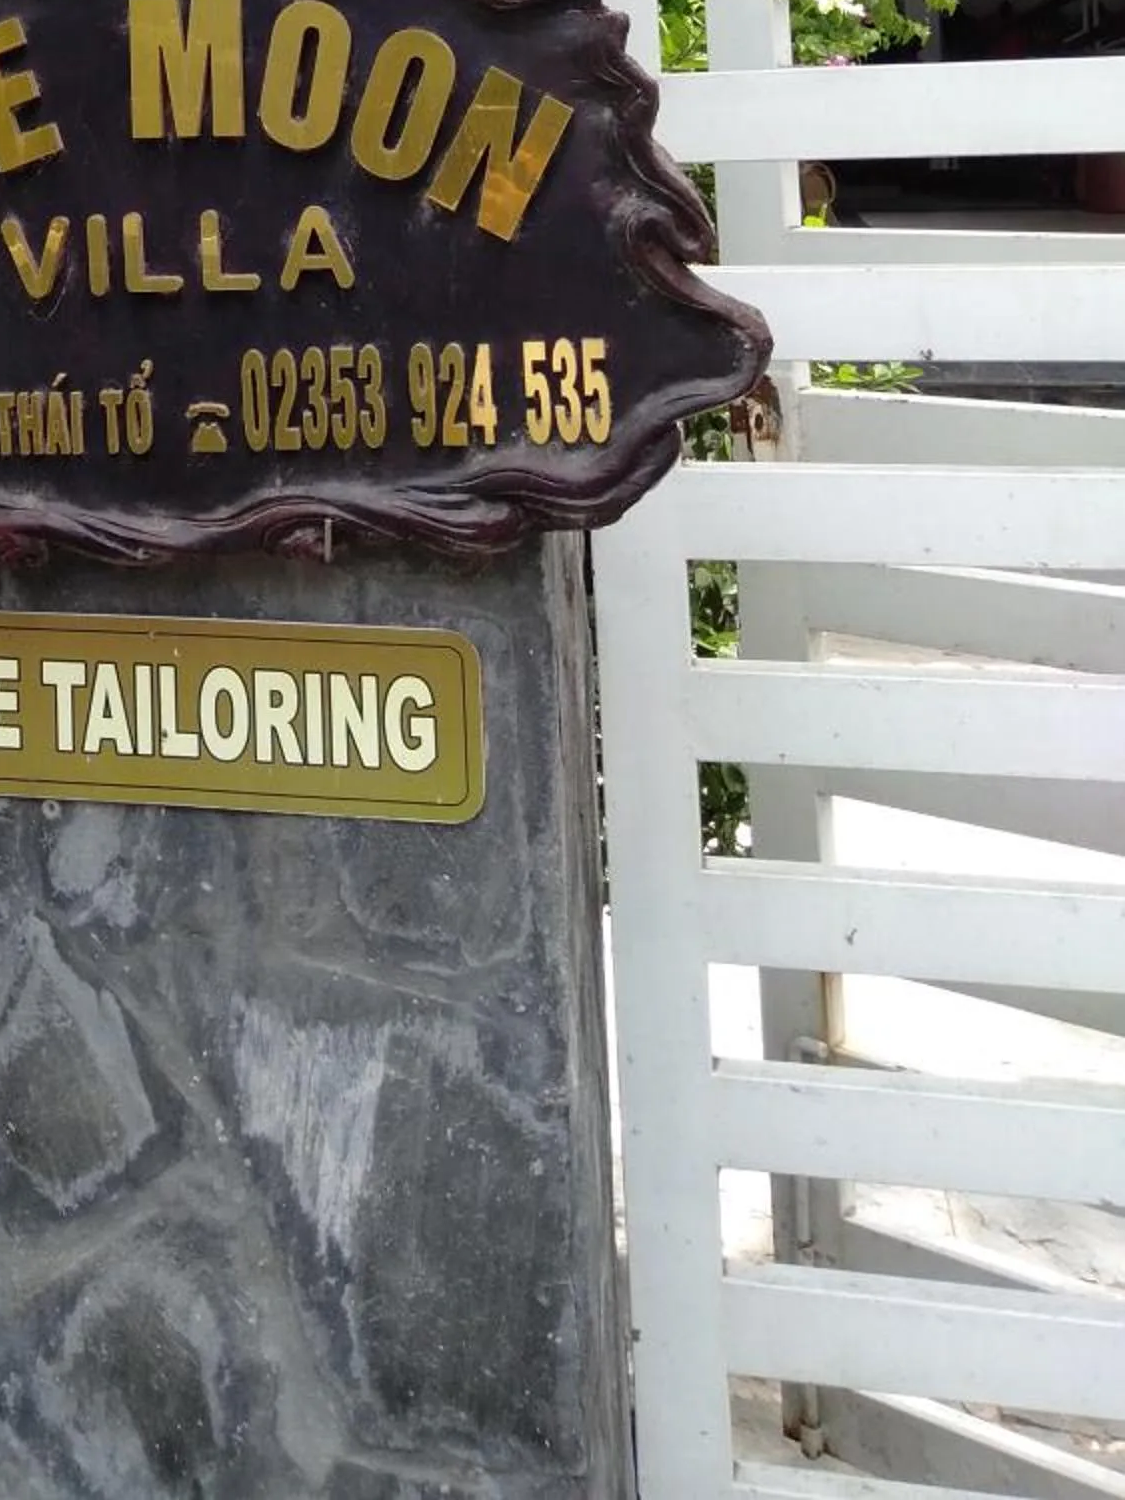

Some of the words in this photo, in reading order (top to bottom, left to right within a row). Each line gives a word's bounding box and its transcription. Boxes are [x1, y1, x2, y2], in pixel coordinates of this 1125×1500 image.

[0, 204, 355, 300] VILLA
[99, 358, 154, 456] TỔ
[241, 342, 385, 454] 02353
[407, 342, 498, 447] 924
[521, 336, 612, 445] 535
[41, 660, 439, 773] TAILORING
